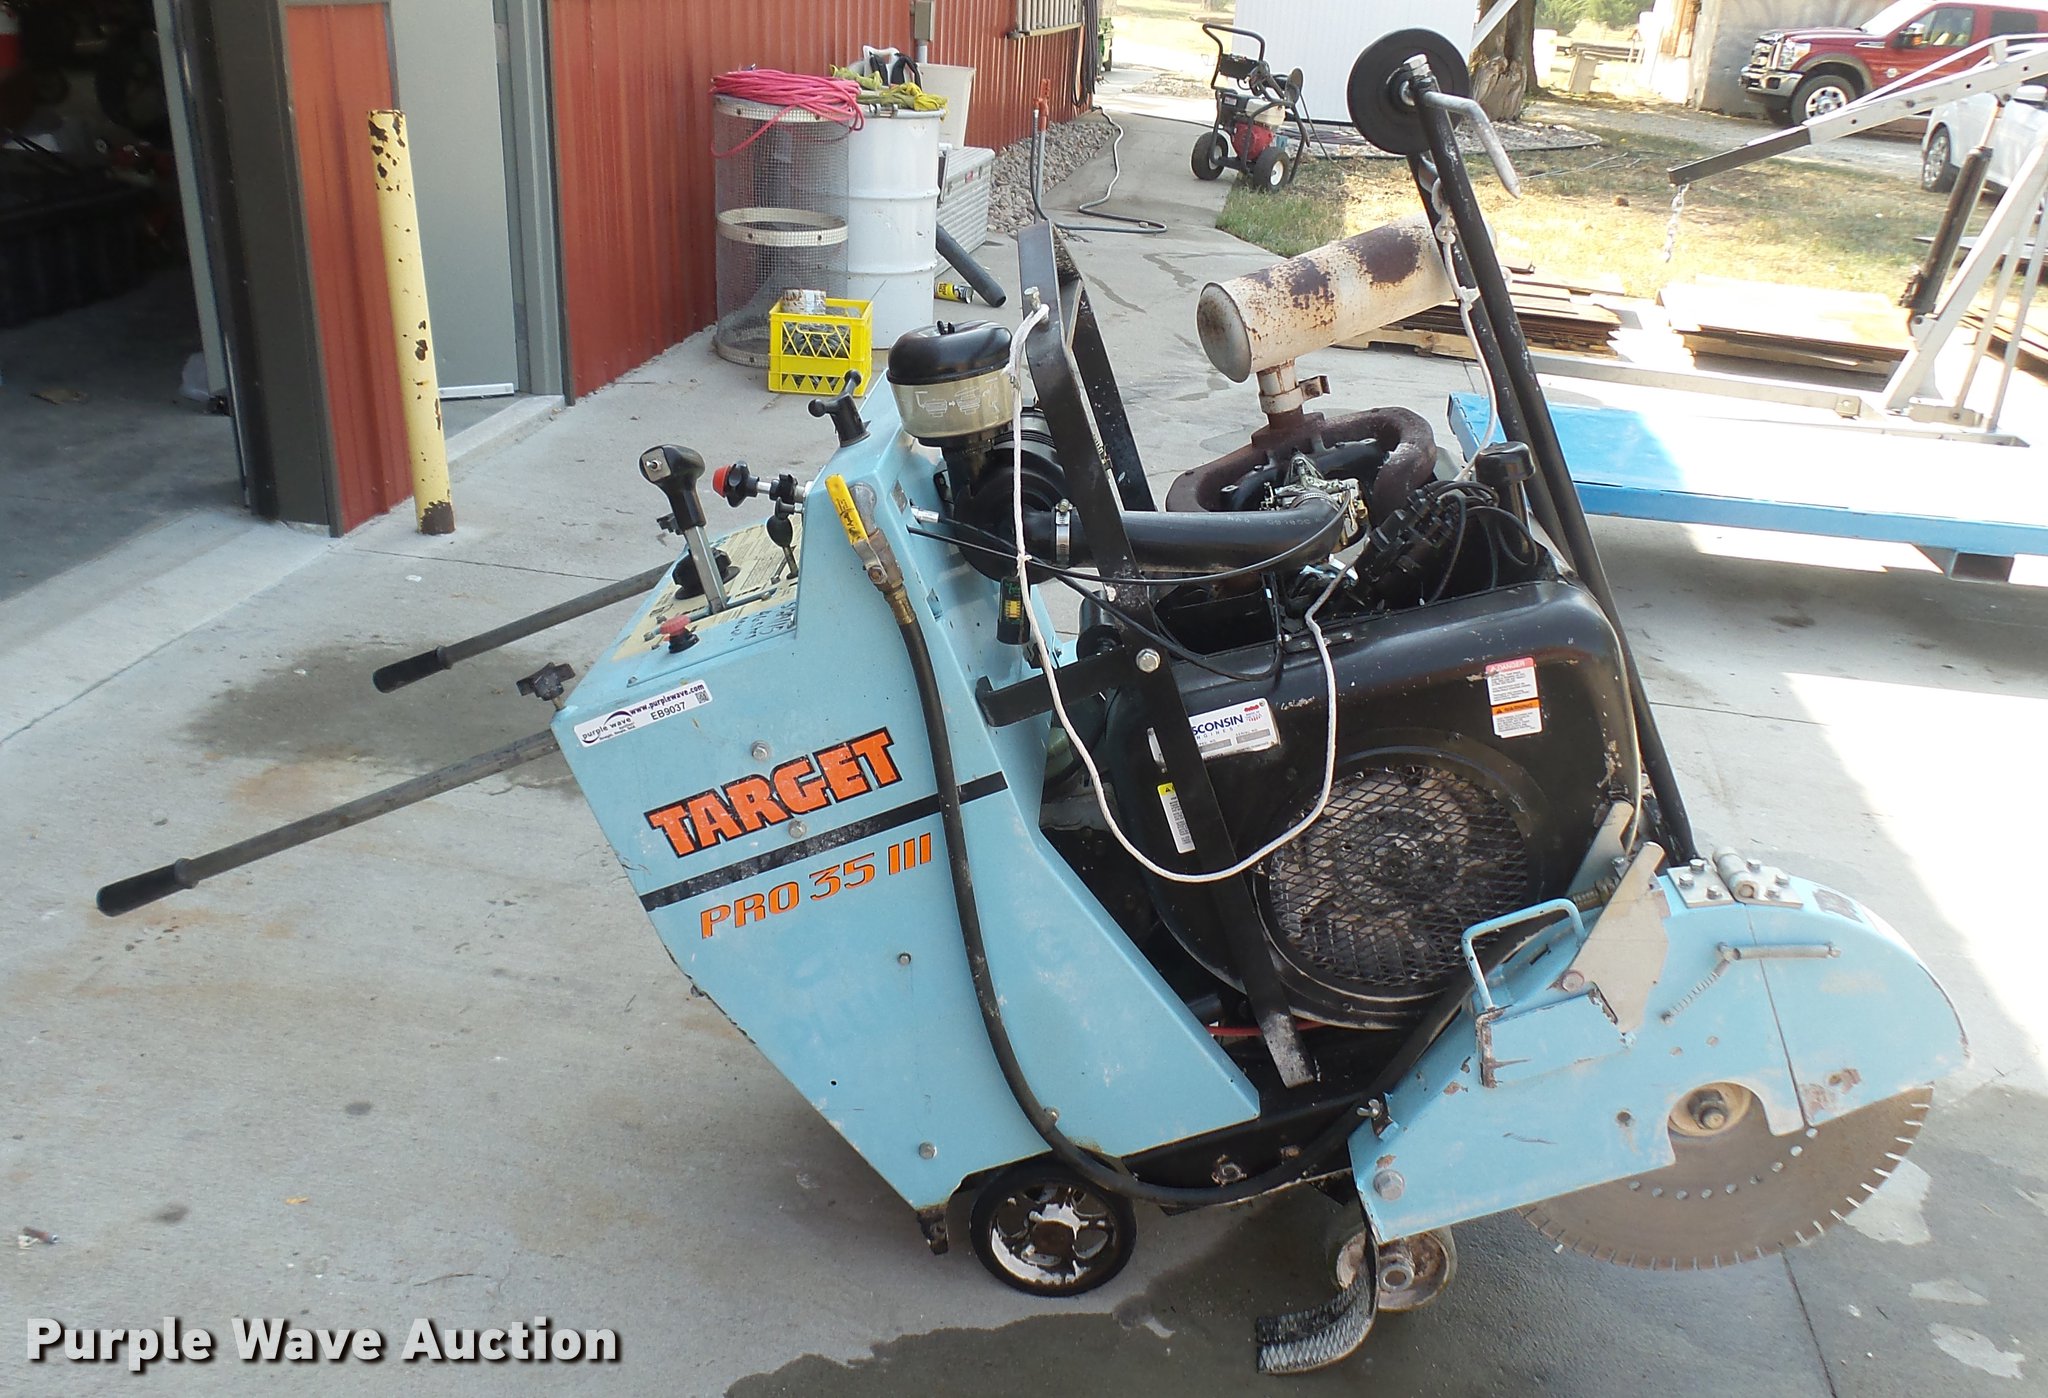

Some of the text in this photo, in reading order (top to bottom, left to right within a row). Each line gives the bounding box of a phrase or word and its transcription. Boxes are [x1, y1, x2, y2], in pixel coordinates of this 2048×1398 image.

[630, 683, 705, 715] www.purplewave.com
[650, 702, 686, 721] EB9037
[582, 725, 609, 740] purple
[609, 717, 632, 729] wave
[1192, 714, 1244, 736] SCONSIN
[1196, 726, 1234, 740] NGINES
[643, 726, 903, 858] TARGET
[700, 832, 932, 939] PRO 35 III
